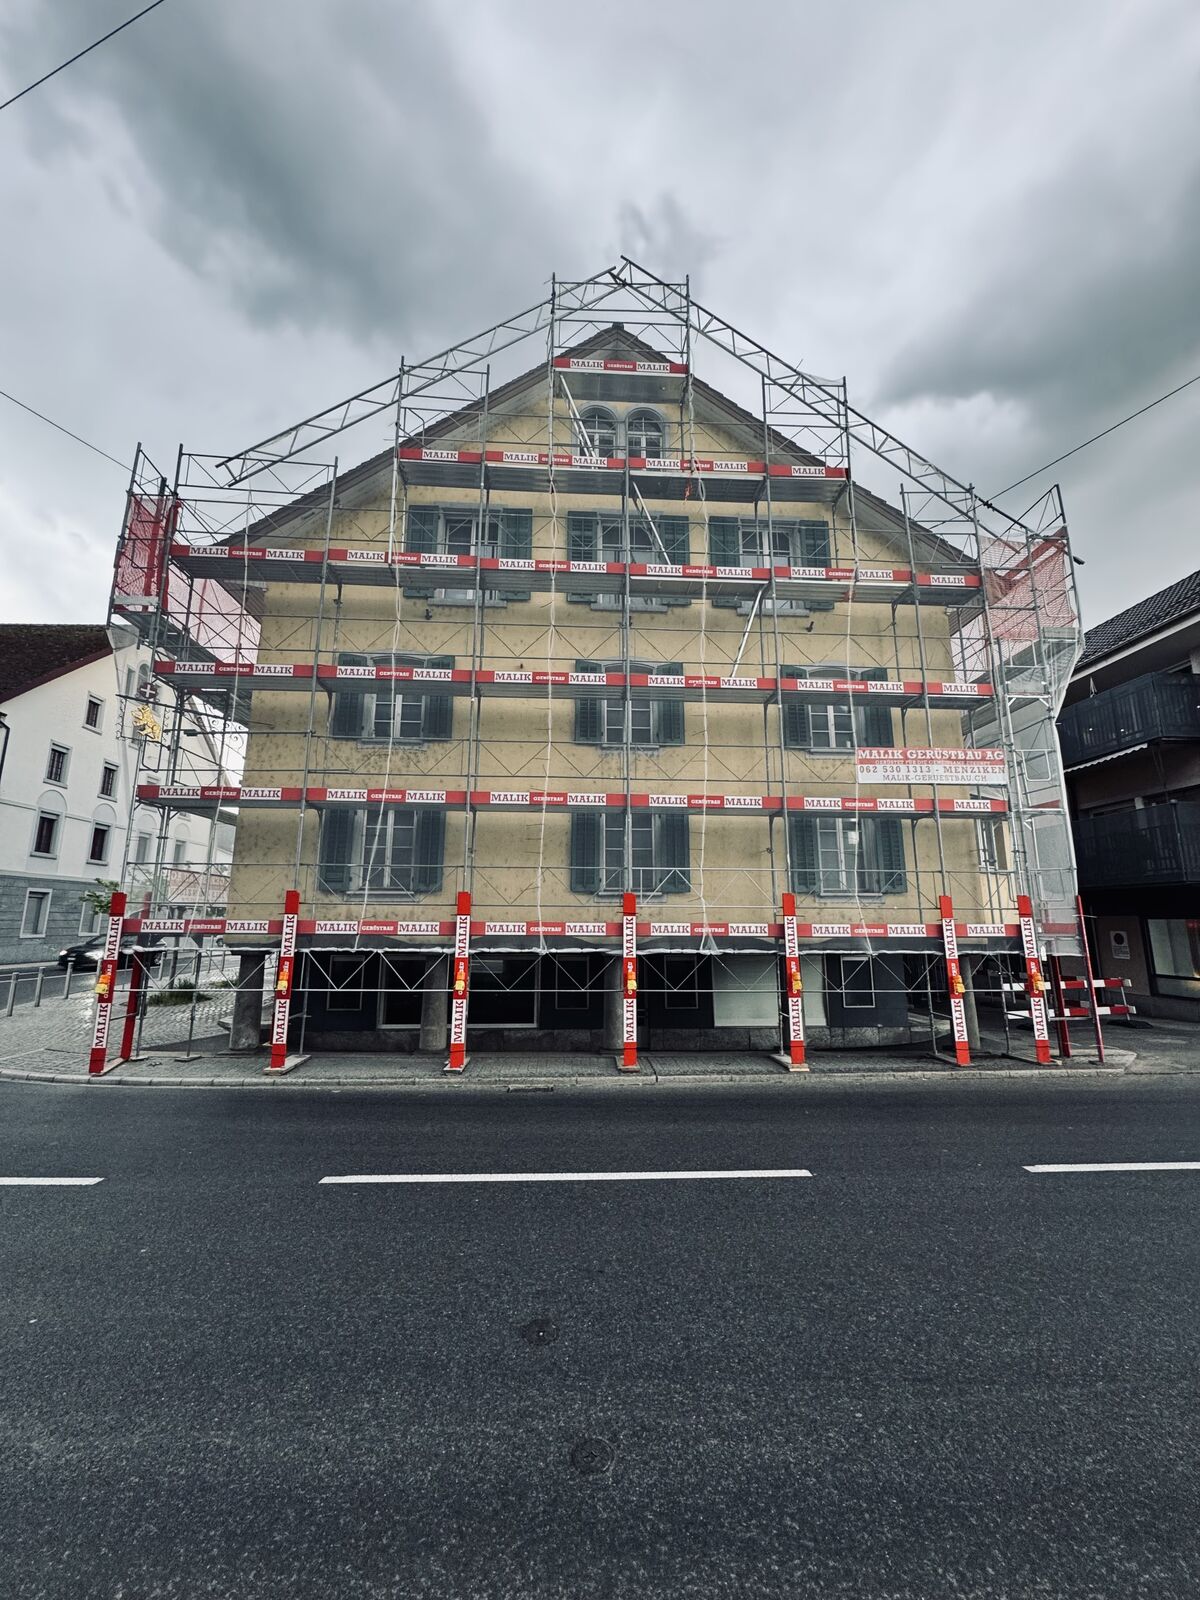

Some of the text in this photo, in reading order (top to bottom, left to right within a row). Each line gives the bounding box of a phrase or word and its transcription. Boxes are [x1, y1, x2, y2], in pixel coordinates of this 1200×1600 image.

[571, 360, 603, 368] MALIK
[638, 363, 669, 371] MALIK
[423, 451, 458, 460] MALIK
[504, 454, 538, 462] MALIK
[573, 458, 607, 466] MALIK
[647, 459, 680, 468] MALIK
[714, 462, 747, 470] MALIK
[792, 467, 824, 475] MALIK
[190, 547, 228, 556] MALIK
[267, 550, 304, 559] MALIK
[348, 552, 384, 560] MALIK
[421, 555, 457, 564] MALIK
[500, 560, 534, 569] MALIK
[571, 563, 606, 571] MALIK
[648, 566, 682, 574] MALIK
[717, 568, 751, 576] MALIK
[792, 568, 825, 577] MALIK
[859, 571, 892, 579] MALIK
[932, 576, 964, 584] MALIK
[176, 663, 214, 672] MALIK
[254, 665, 292, 674] MALIK
[338, 667, 375, 677] MALIK
[414, 670, 450, 679] MALIK
[496, 672, 531, 681] MALIK
[570, 674, 605, 683] MALIK
[649, 677, 684, 685] MALIK
[721, 679, 756, 687] MALIK
[798, 681, 832, 689] MALIK
[868, 683, 903, 691] MALIK
[943, 684, 976, 693] MALIK
[858, 748, 1004, 760] MALIK GERÜSTBAU AG
[160, 787, 200, 797] MALIK
[241, 789, 281, 798] MALIK
[328, 790, 366, 799] MALIK
[407, 792, 444, 801] MALIK
[491, 793, 528, 802] MALIK
[568, 795, 605, 804] MALIK
[650, 797, 686, 805] MALIK
[725, 798, 761, 806] MALIK
[805, 799, 841, 808] MALIK
[878, 800, 914, 809] MALIK
[955, 801, 990, 809] MALIK
[142, 921, 183, 930] MALIK
[227, 922, 267, 931] MALIK
[317, 922, 356, 932] MALIK
[399, 923, 438, 932] MALIK
[487, 923, 526, 933] MALIK
[567, 925, 605, 934] MALIK
[652, 925, 690, 934] MALIK
[730, 926, 767, 934] MALIK
[813, 926, 850, 934] MALIK
[888, 926, 925, 935] MALIK
[968, 926, 1004, 934] MALIK
[106, 917, 121, 960] MALIK
[283, 915, 295, 956] MALIK
[458, 916, 468, 956] MALIK
[626, 917, 634, 957] MALIK
[786, 917, 796, 956] MALIK
[945, 919, 957, 958] MALIK
[1023, 918, 1037, 958] MALIK
[275, 1001, 288, 1043] MALIK
[454, 1001, 464, 1042] MALIK
[626, 1000, 634, 1041] MALIK
[791, 999, 801, 1039] MALIK
[954, 1000, 966, 1040] MALIK
[1033, 999, 1046, 1039] MALIK
[95, 1003, 109, 1048] MALIK
